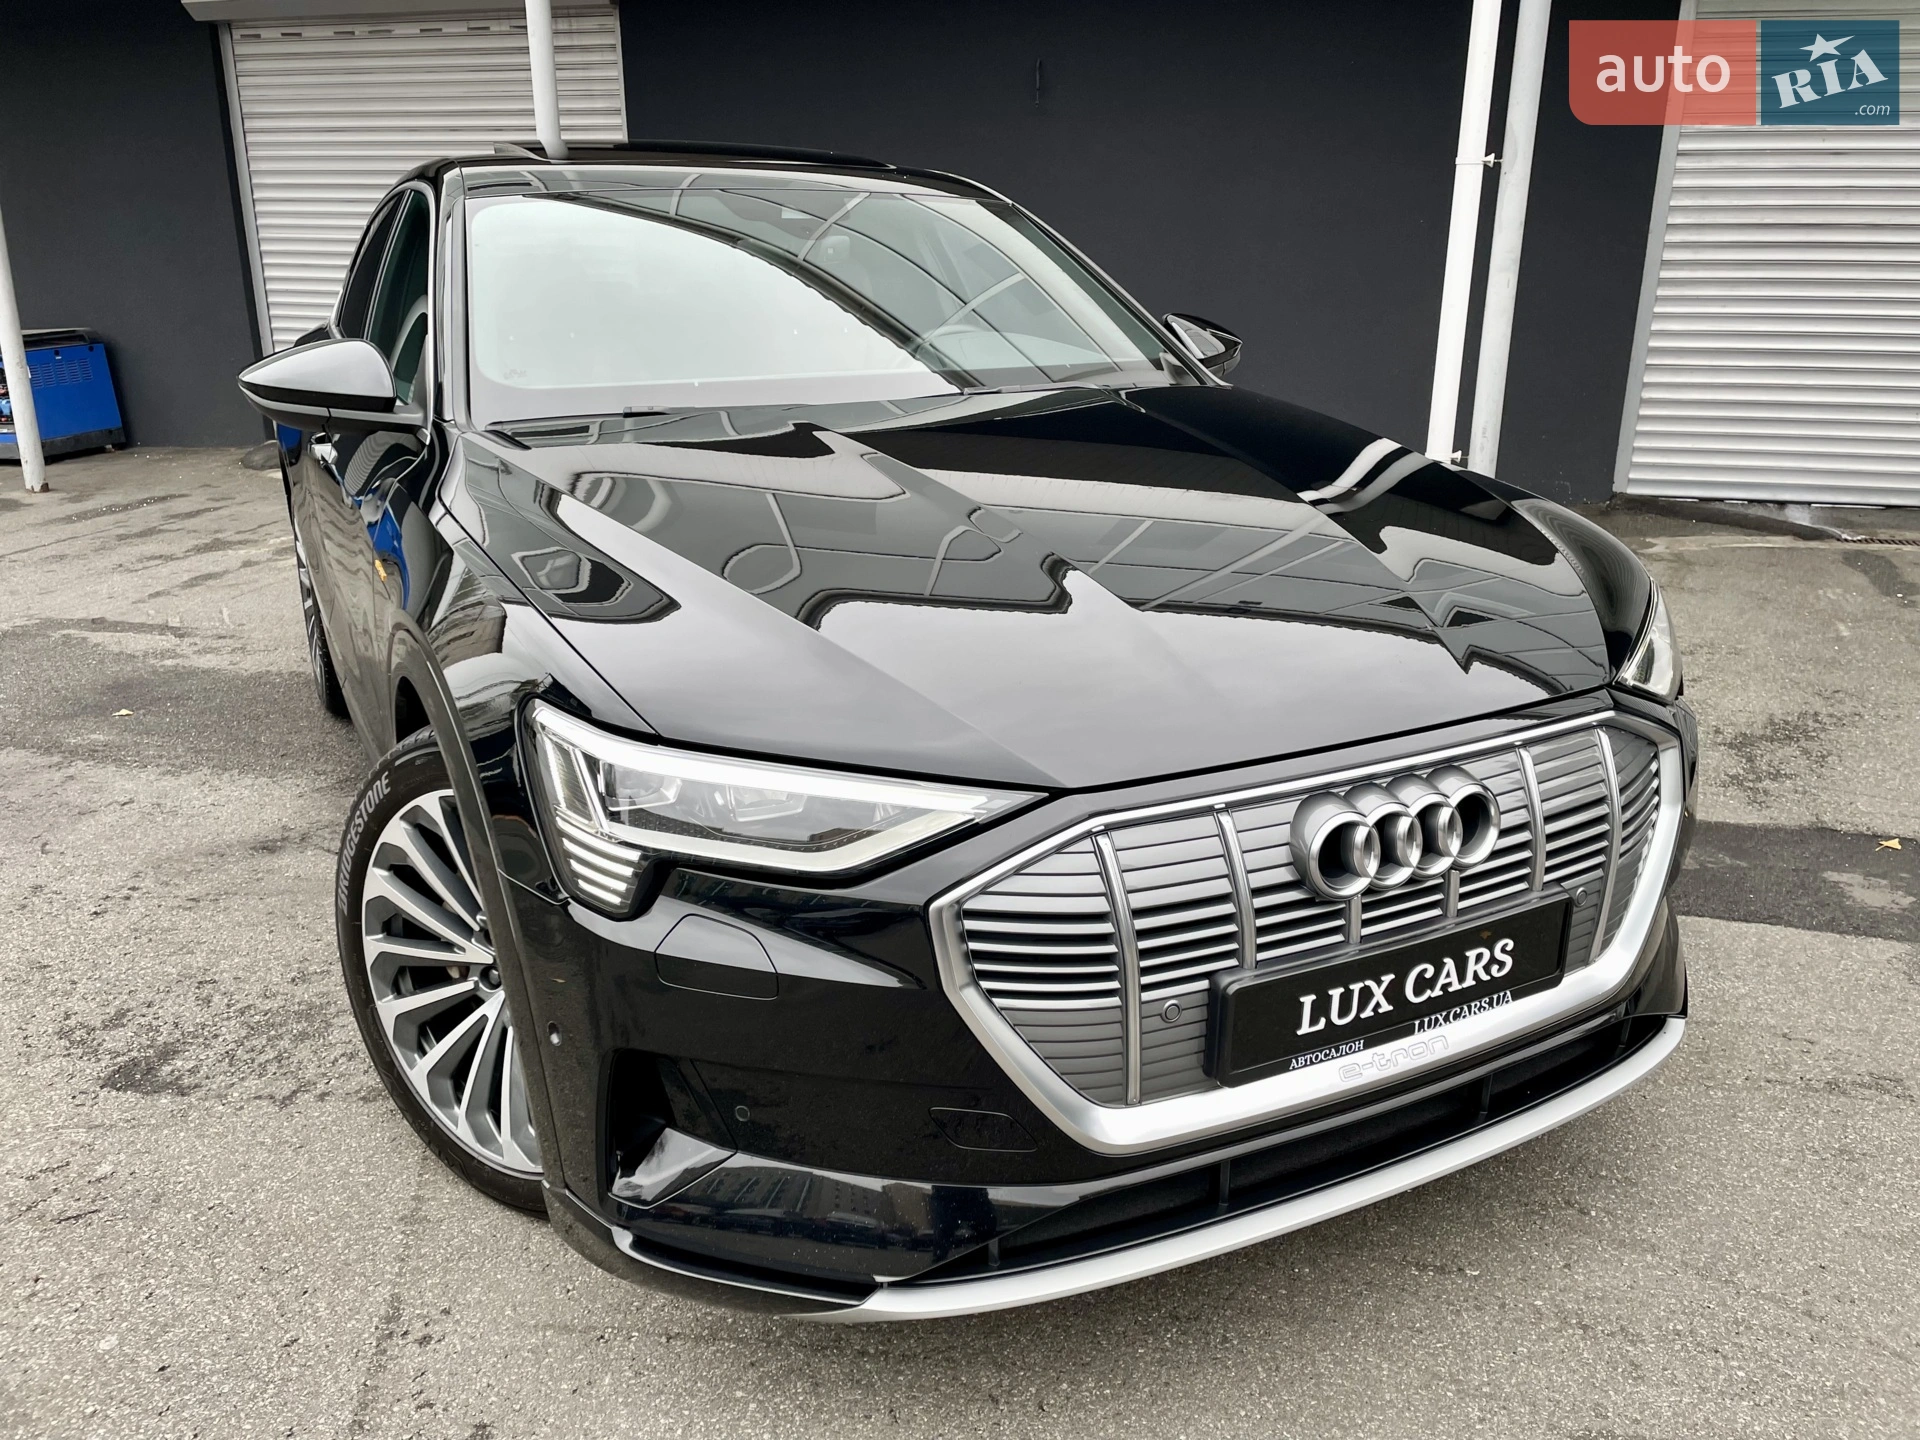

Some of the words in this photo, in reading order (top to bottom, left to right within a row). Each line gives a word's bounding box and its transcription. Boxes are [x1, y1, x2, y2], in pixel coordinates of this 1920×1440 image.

[338, 771, 391, 916] BRIDGESTONE
[1295, 974, 1395, 1036] LUX
[1404, 937, 1515, 1004] CARS
[1289, 1039, 1365, 1070] АВТОСАЛОН
[1338, 1034, 1450, 1083] e-tron
